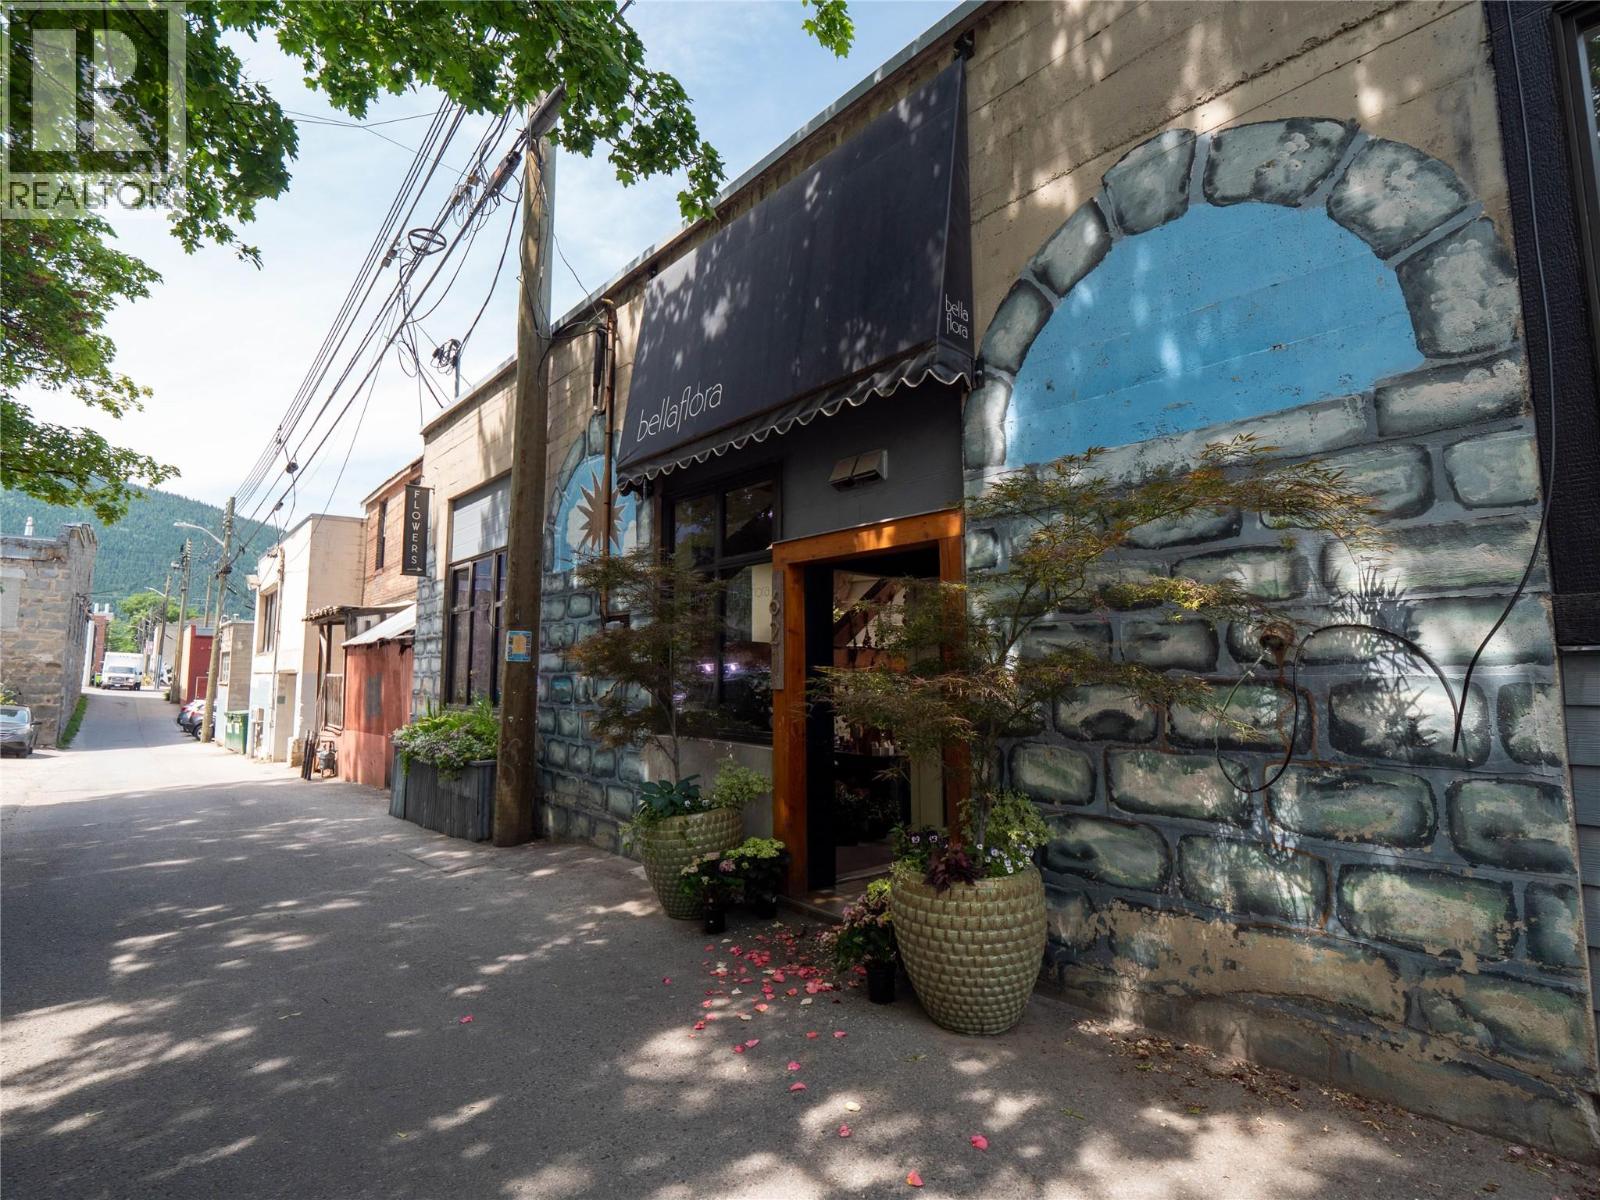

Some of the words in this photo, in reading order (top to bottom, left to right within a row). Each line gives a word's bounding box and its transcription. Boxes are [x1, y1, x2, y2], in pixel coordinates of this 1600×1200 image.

[945, 293, 969, 322] bella
[946, 312, 969, 340] flora
[636, 381, 723, 442] bellaflora
[411, 490, 421, 565] FLOWERS
